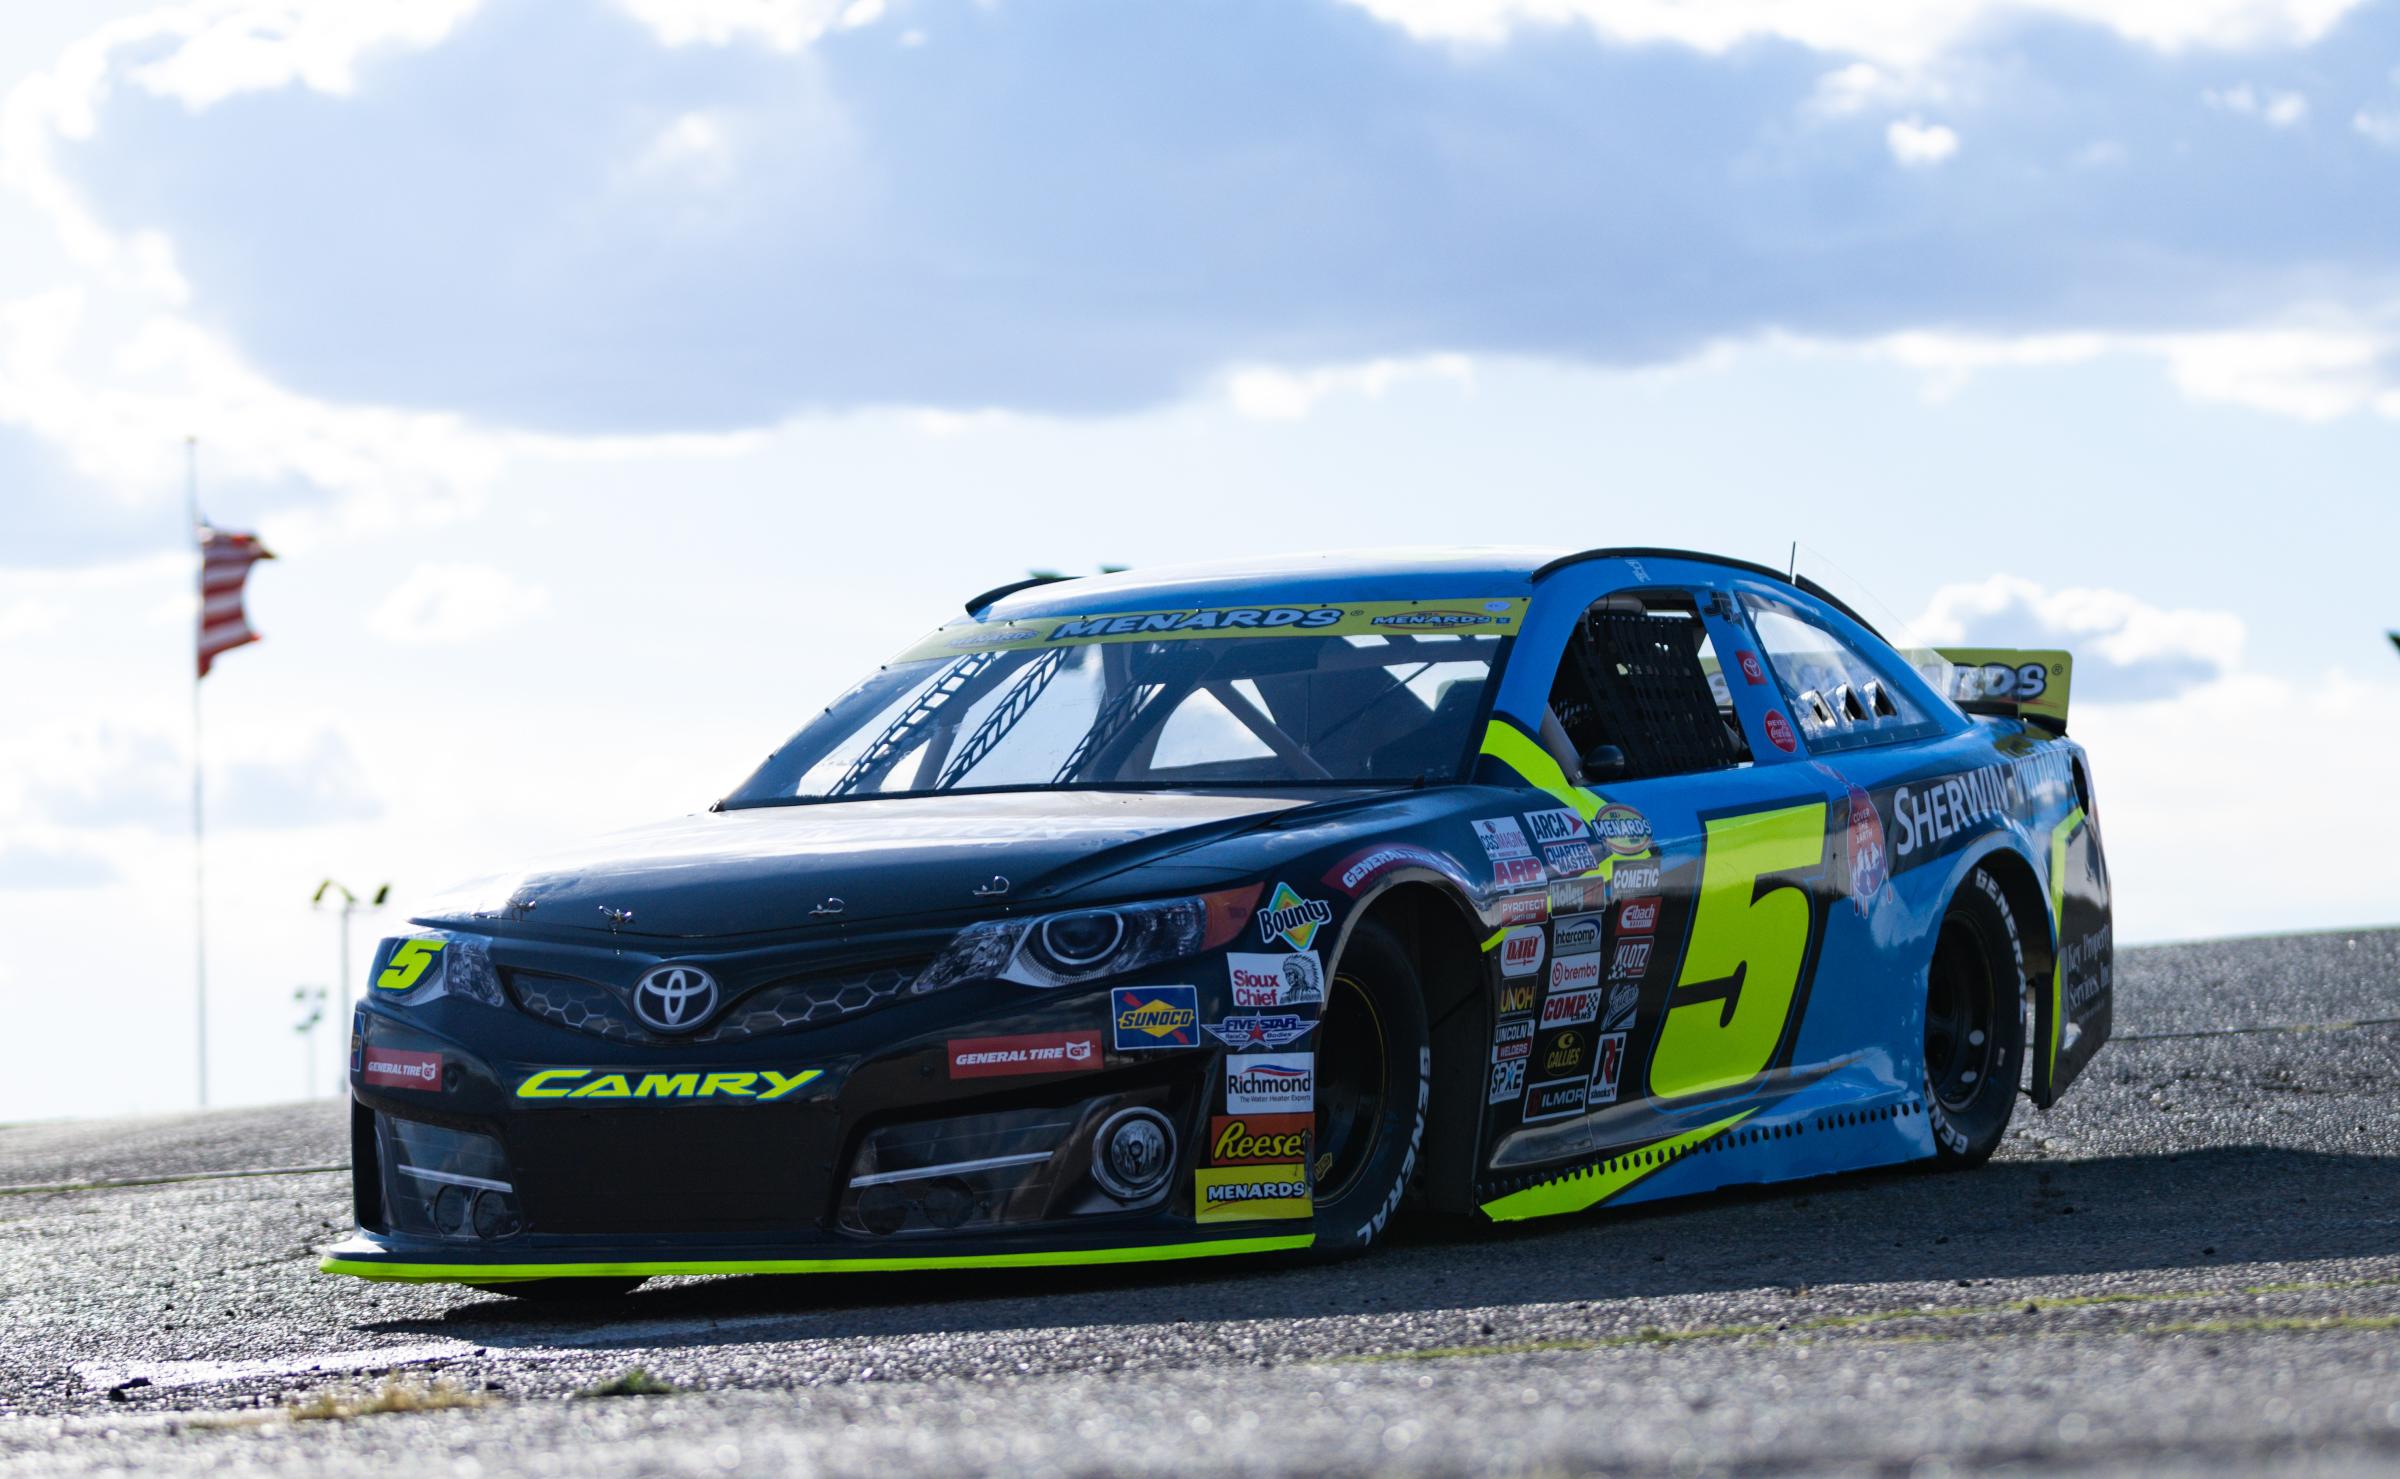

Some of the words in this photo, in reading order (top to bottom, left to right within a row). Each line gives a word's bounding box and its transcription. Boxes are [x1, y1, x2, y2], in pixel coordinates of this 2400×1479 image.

[1049, 608, 1342, 642] MENARDS
[1371, 615, 1492, 626] MENARDS
[1853, 808, 1870, 823] COVER
[1531, 813, 1570, 841] ARCA
[1591, 819, 1653, 839] MENARDS
[1858, 822, 1868, 830] THE
[1856, 831, 1872, 844] EARTH
[1545, 843, 1589, 864] QUARTER
[1342, 849, 1407, 888] GENERAL
[1495, 859, 1541, 885] ARP
[1557, 857, 1596, 873] MASTER
[1614, 868, 1660, 889] COMETIC
[1502, 899, 1545, 913] PYROTECT
[1552, 883, 1584, 912] Holley
[1259, 899, 1331, 942] Bounty
[1621, 904, 1655, 927] Eibach
[1555, 928, 1596, 945] Intercomp
[1976, 867, 2026, 1024] GENERAL
[1616, 944, 1649, 967] KLOTZ
[1651, 802, 1827, 1098] 5
[377, 939, 448, 989] 5
[1564, 963, 1597, 980] brembo
[1233, 969, 1280, 988] Sioux
[1236, 989, 1277, 1006] Chief
[1501, 986, 1536, 1014] UNOH
[1543, 995, 1588, 1021] COMP
[1120, 1010, 1194, 1029] SUNOCO
[1226, 1019, 1255, 1032] FIVE
[1260, 1018, 1297, 1030] STAR
[1495, 1024, 1527, 1043] LINCOLN
[956, 1049, 1027, 1066] GENERAL
[1030, 1047, 1064, 1060] TIRE
[1500, 1044, 1528, 1057] WELDERS
[1547, 1049, 1580, 1070] CALLIES
[368, 1061, 401, 1074] GENERAL
[403, 1065, 422, 1077] TIRE
[516, 1068, 824, 1100] CAMRY
[1228, 1071, 1311, 1094] Richmond
[1542, 1088, 1585, 1107] ILMOR
[1591, 1088, 1611, 1099] shocks
[1356, 1045, 1431, 1248] GENERAL
[1207, 1183, 1305, 1202] MENARDS
